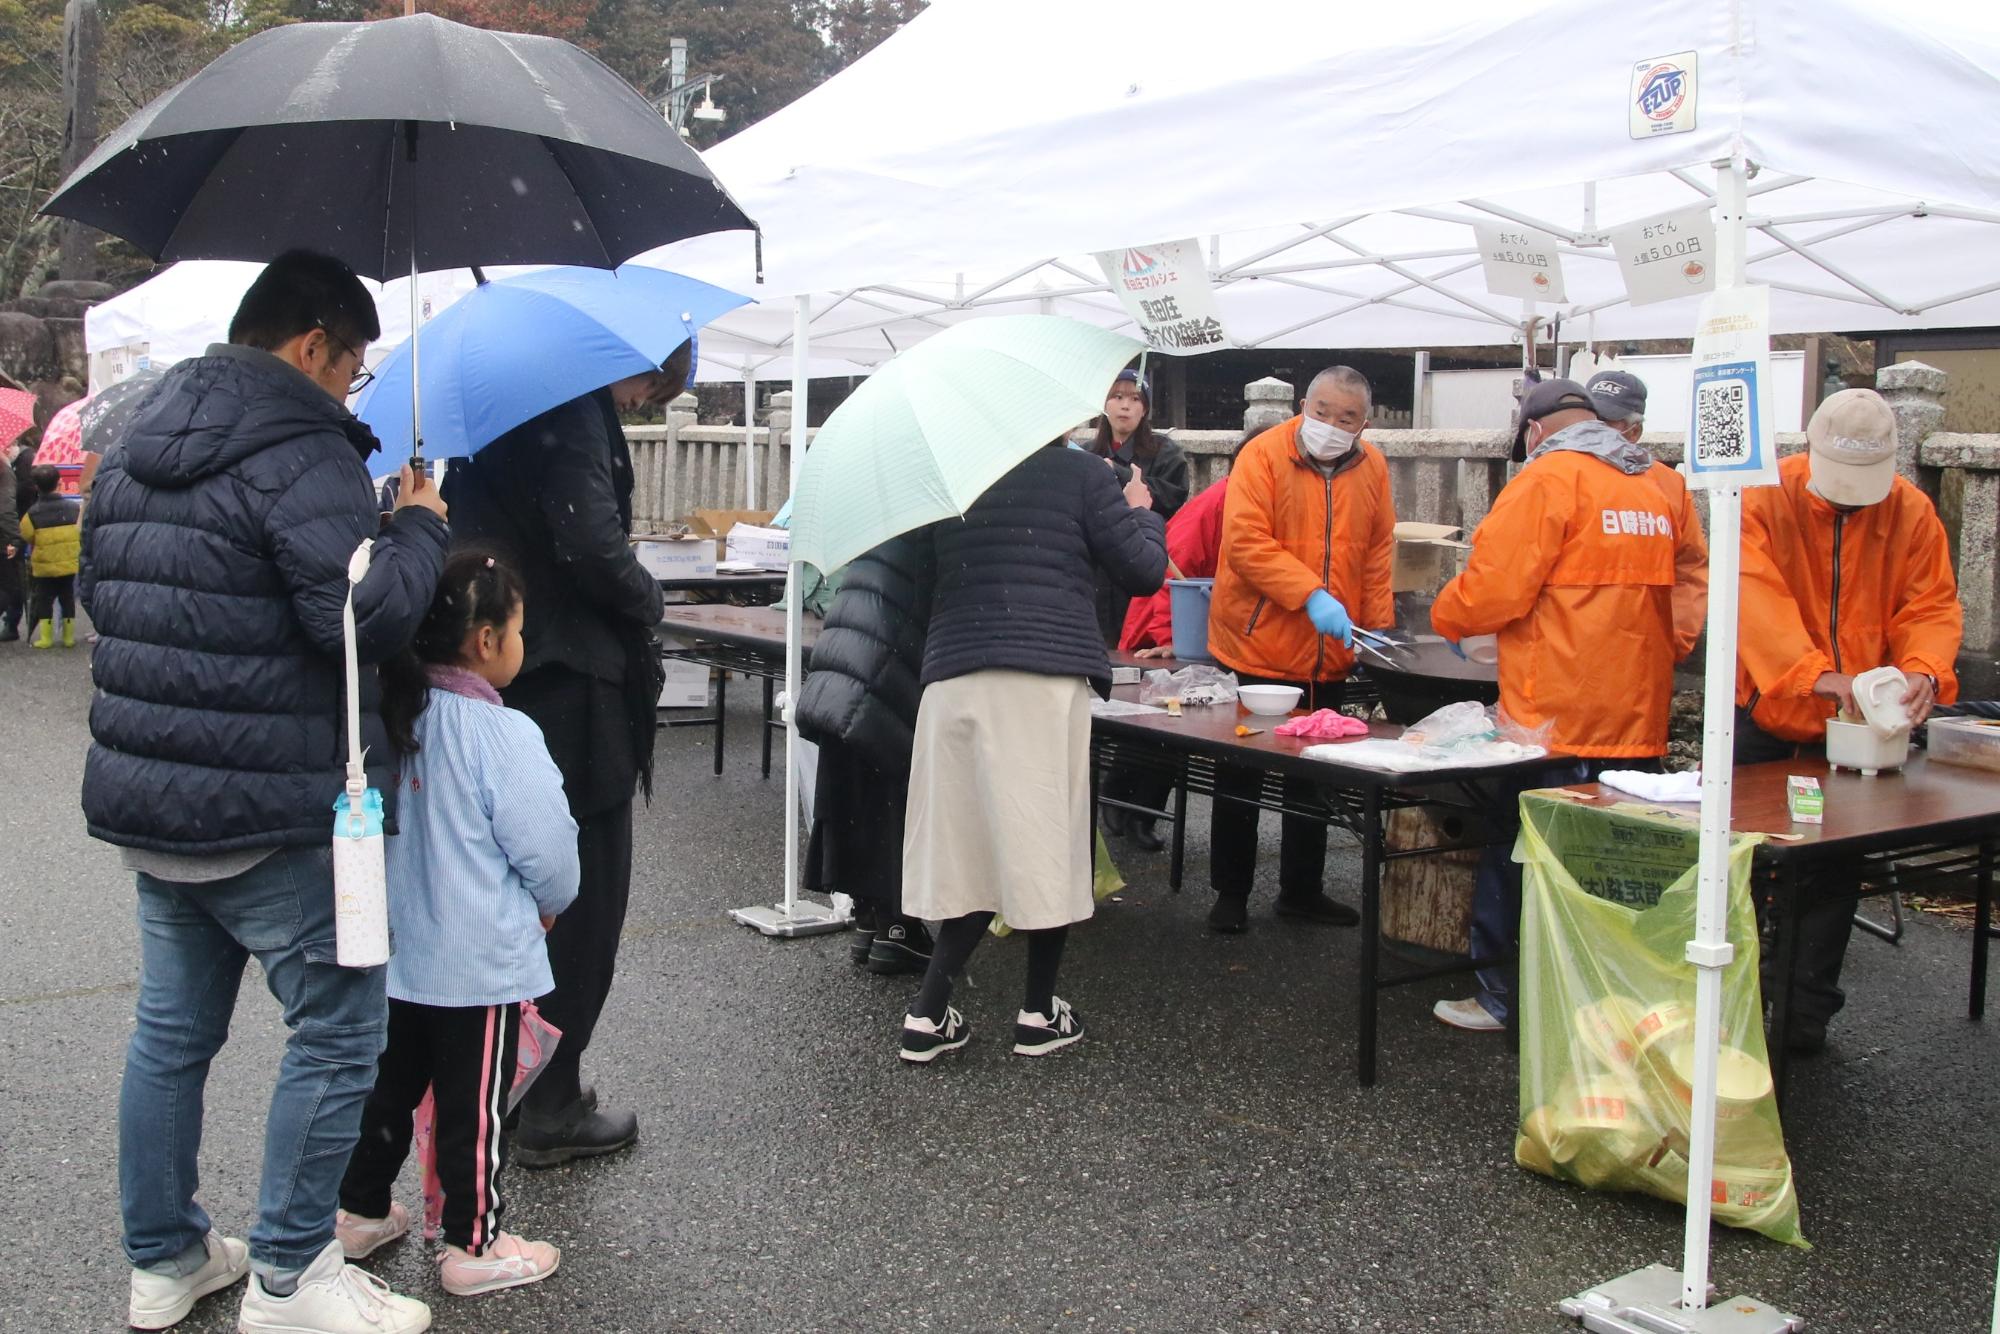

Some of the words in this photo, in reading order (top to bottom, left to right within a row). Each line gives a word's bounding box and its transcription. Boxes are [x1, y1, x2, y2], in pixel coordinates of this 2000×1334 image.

[1499, 232, 1528, 246] おでん
[1641, 220, 1677, 239] おでん
[1139, 295, 1183, 322] 黒田庄
[1602, 510, 1673, 540] 日時計の
